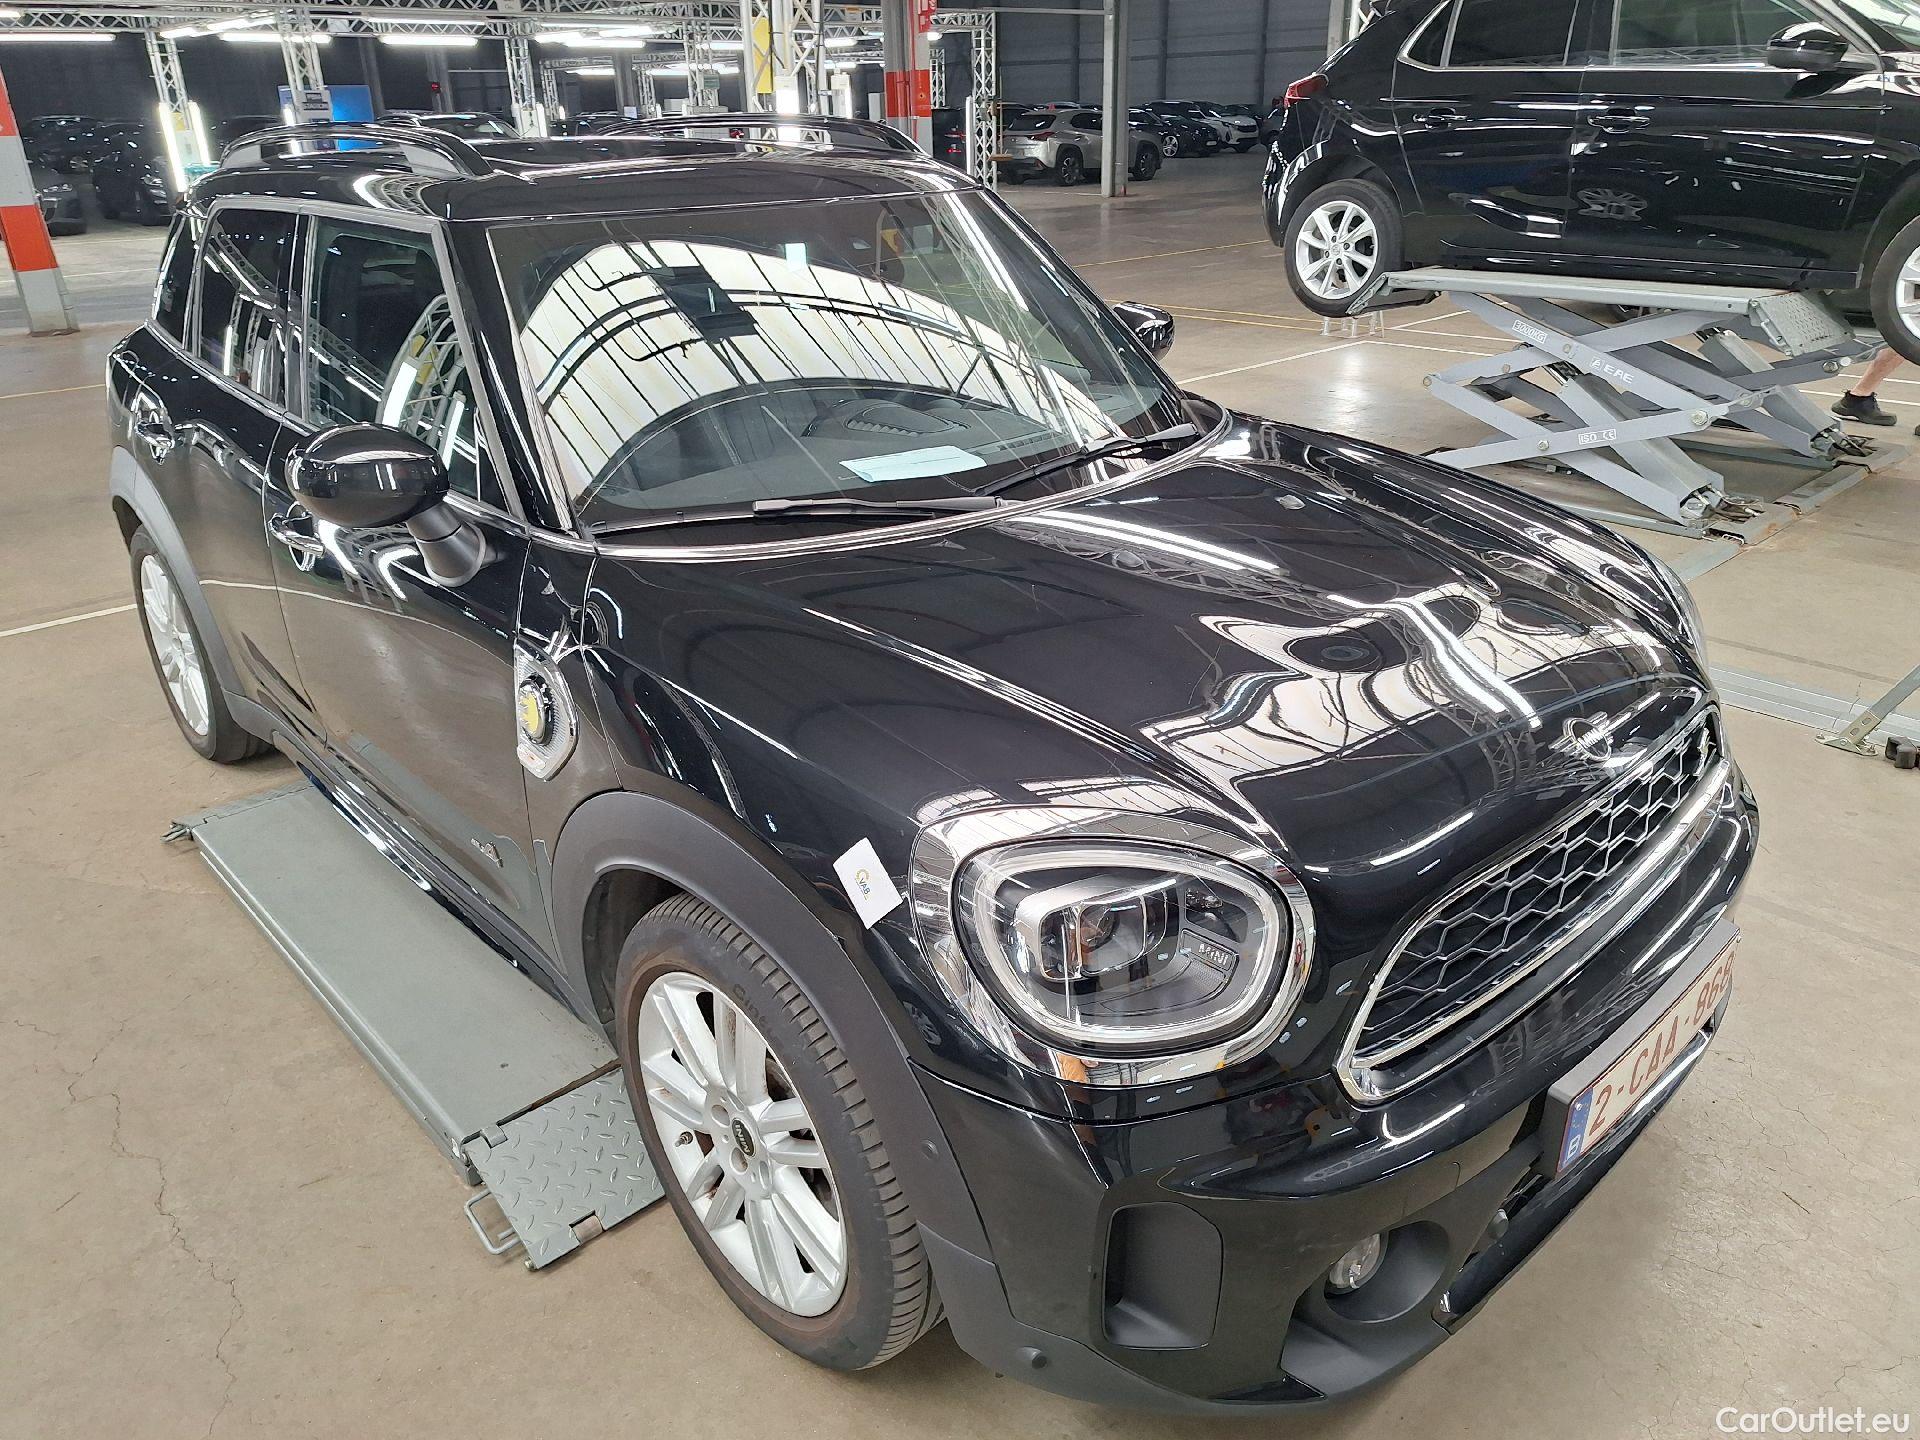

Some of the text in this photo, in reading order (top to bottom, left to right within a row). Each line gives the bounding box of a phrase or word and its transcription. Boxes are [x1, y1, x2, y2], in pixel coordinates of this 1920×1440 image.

[1515, 321, 1546, 341] 3000KG
[1604, 364, 1634, 384] EAE
[1580, 433, 1598, 444] ISO
[859, 877, 871, 895] VAB
[1199, 943, 1229, 966] MINI
[1589, 950, 1735, 1137] 2-CAA-868
[735, 1124, 751, 1153] MINI
[1565, 1134, 1581, 1161] B
